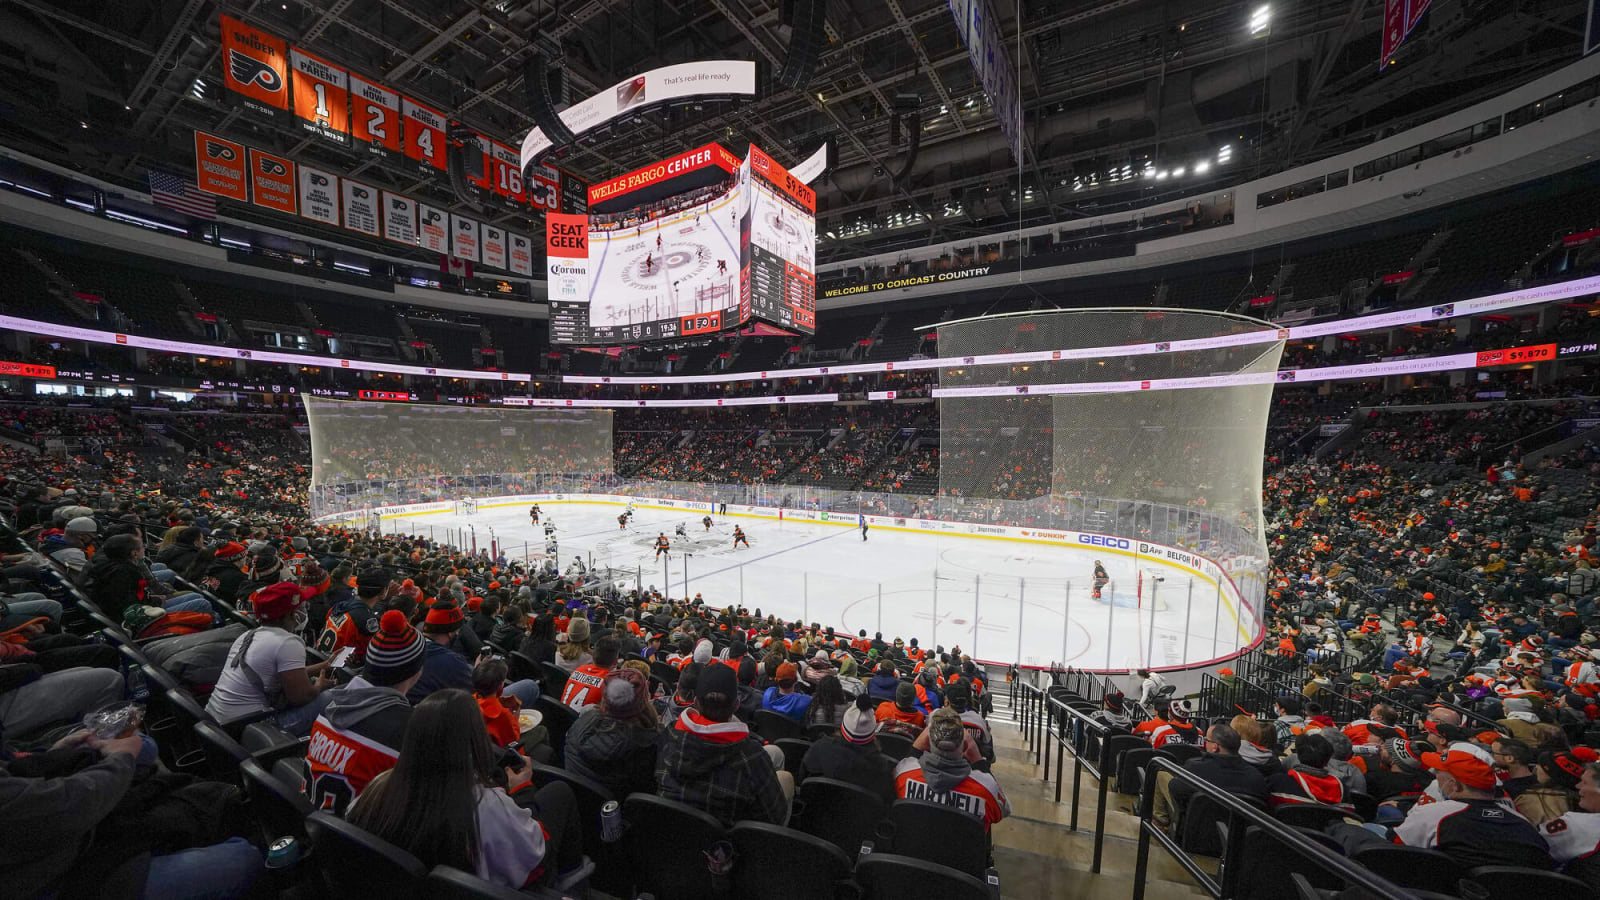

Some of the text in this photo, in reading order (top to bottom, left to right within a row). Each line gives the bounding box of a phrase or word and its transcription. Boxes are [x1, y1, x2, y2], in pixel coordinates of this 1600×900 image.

[234, 32, 275, 56] SNIDER
[300, 61, 338, 84] PARENT
[664, 77, 683, 85] That's
[685, 75, 697, 83] real
[710, 72, 731, 82] ready
[313, 83, 329, 118] 1
[363, 88, 388, 106] HOWE
[367, 105, 386, 139] 2
[411, 108, 440, 129] ASHBEE
[417, 128, 434, 158] 4
[499, 163, 522, 194] 16
[591, 149, 711, 201] WELLS FARGO CENTER
[786, 176, 811, 203] $9,870
[552, 223, 584, 236] SEAT
[550, 236, 585, 249] GEEK
[551, 264, 586, 276] Corona
[825, 267, 991, 297] WELCOME TO COMCAST COUNTRY
[646, 327, 651, 335] 0
[661, 324, 677, 332] 19:36
[687, 319, 691, 328] 1
[1510, 349, 1548, 360] $9,870
[1560, 345, 1581, 354] 2:07
[1582, 344, 1598, 352] PM
[1420, 359, 1456, 370] purchases
[1078, 534, 1129, 550] GEICO
[1167, 550, 1191, 564] BELFOR
[563, 683, 590, 709] 14
[310, 730, 356, 774] GIROUX
[907, 780, 983, 816] HARTNELL
